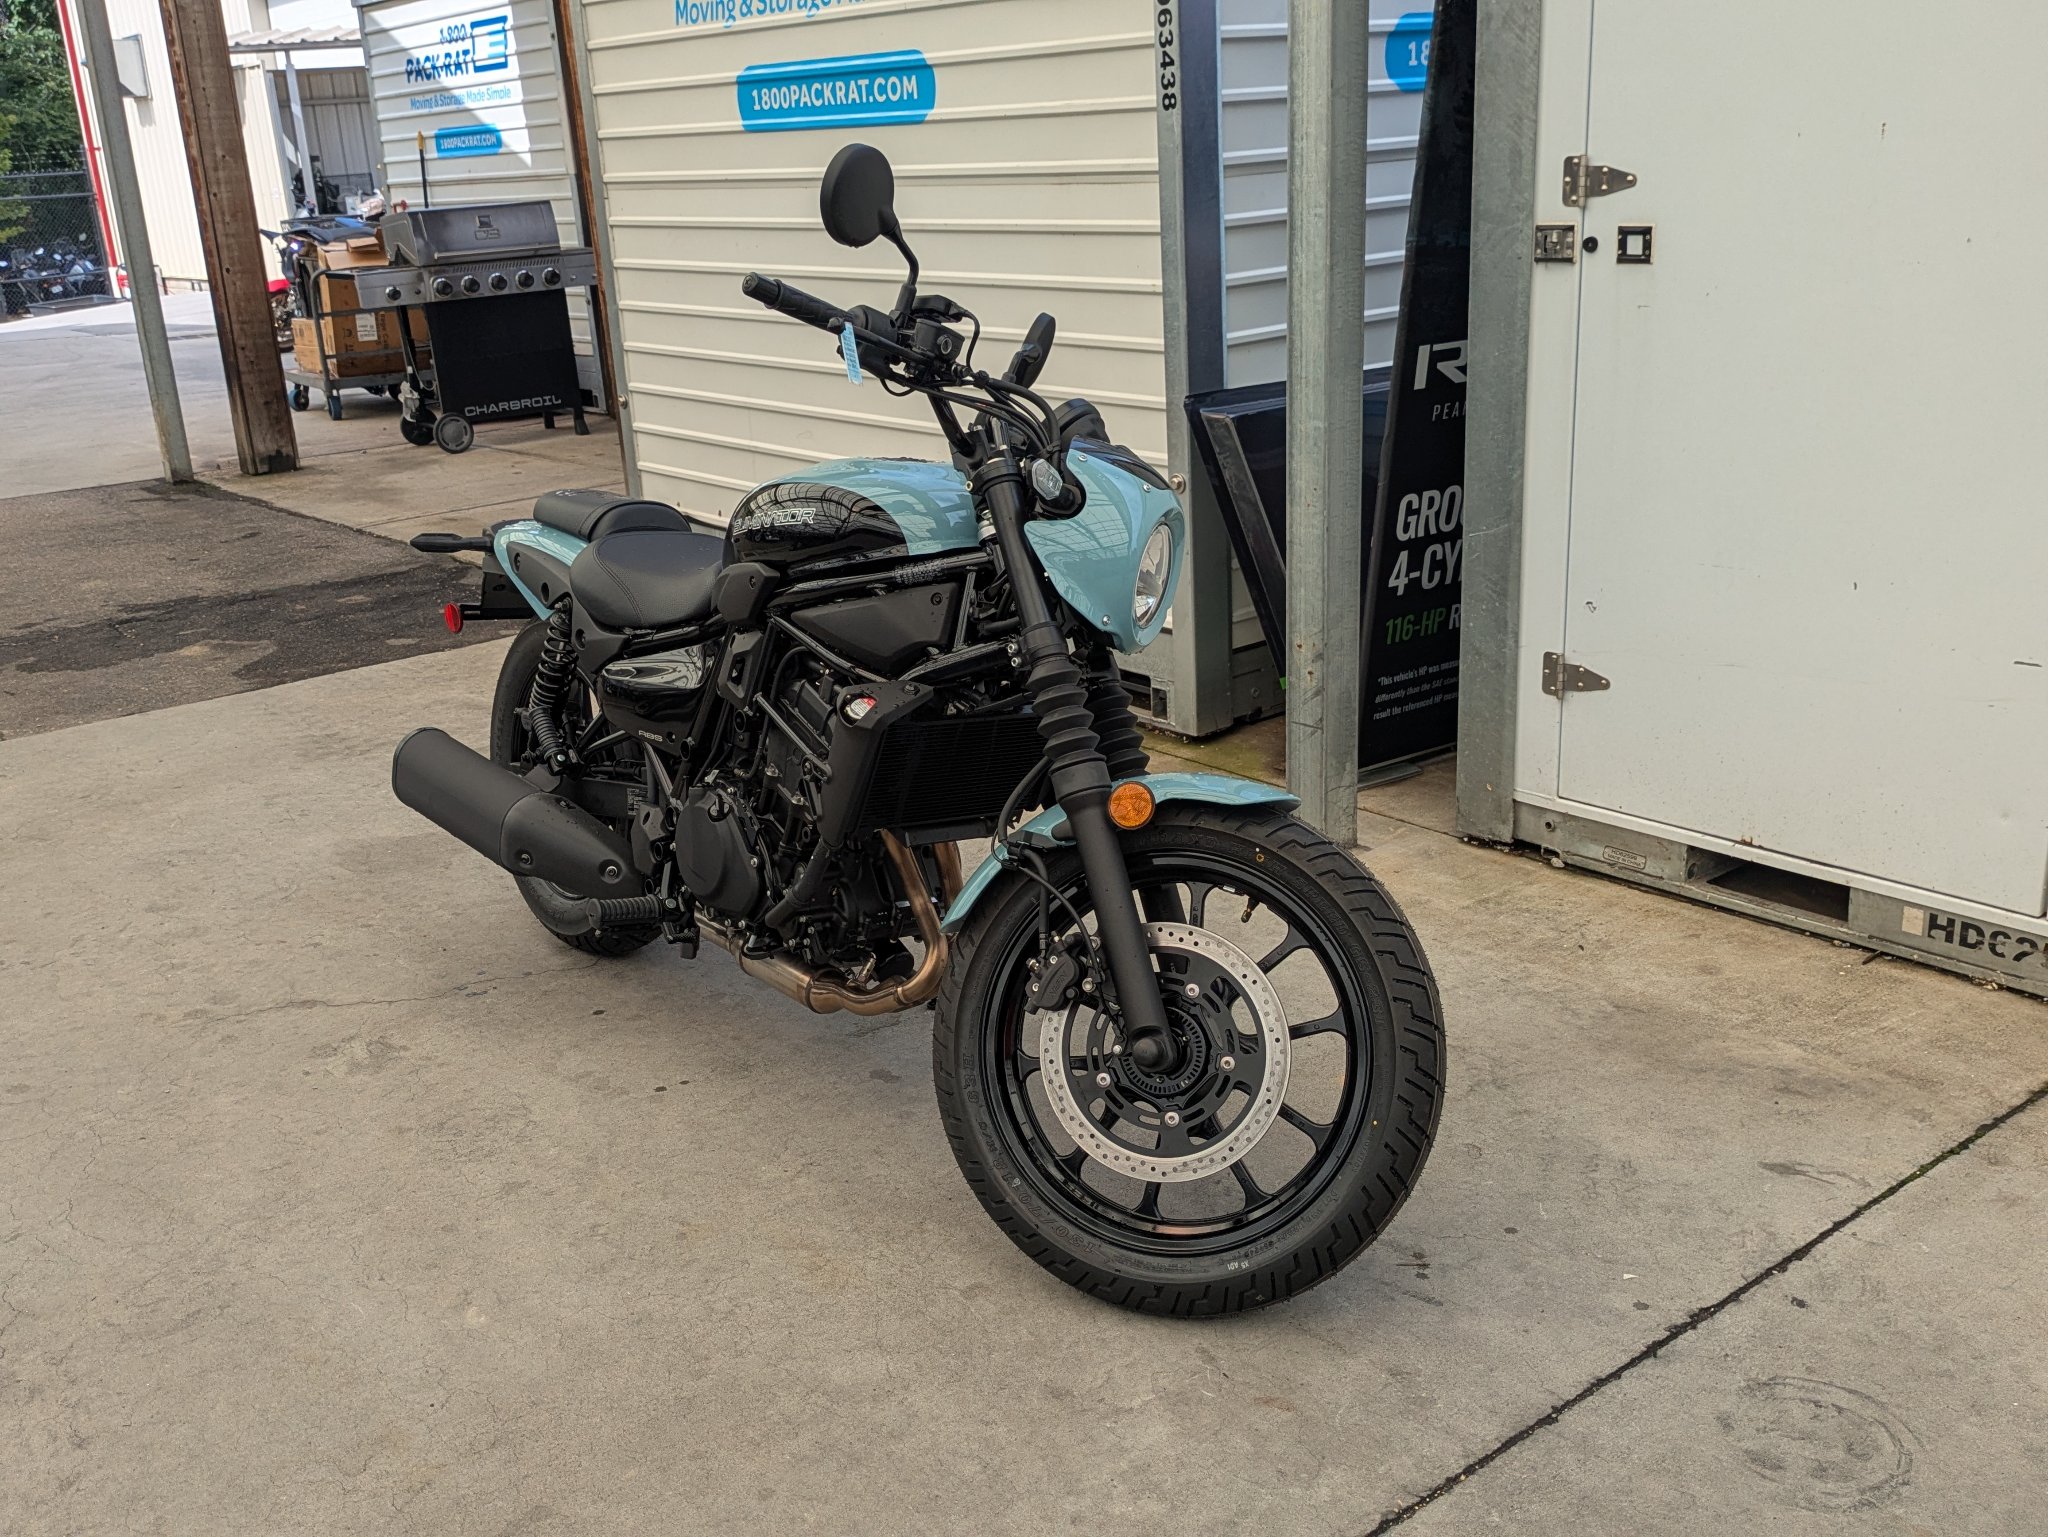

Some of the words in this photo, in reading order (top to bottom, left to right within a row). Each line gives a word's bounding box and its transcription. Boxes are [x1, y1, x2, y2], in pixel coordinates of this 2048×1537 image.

[1157, 0, 1177, 111] 63438
[466, 88, 485, 103] Made
[751, 75, 918, 110] 1800PACKRAT.COM
[440, 133, 498, 150] 1800PACKRAT.COM
[464, 395, 562, 417] CHARBROIL
[1396, 485, 1464, 542] GRO
[1388, 539, 1463, 596] 4-CY
[1385, 606, 1447, 645] 116-HP
[1418, 665, 1428, 676] HP
